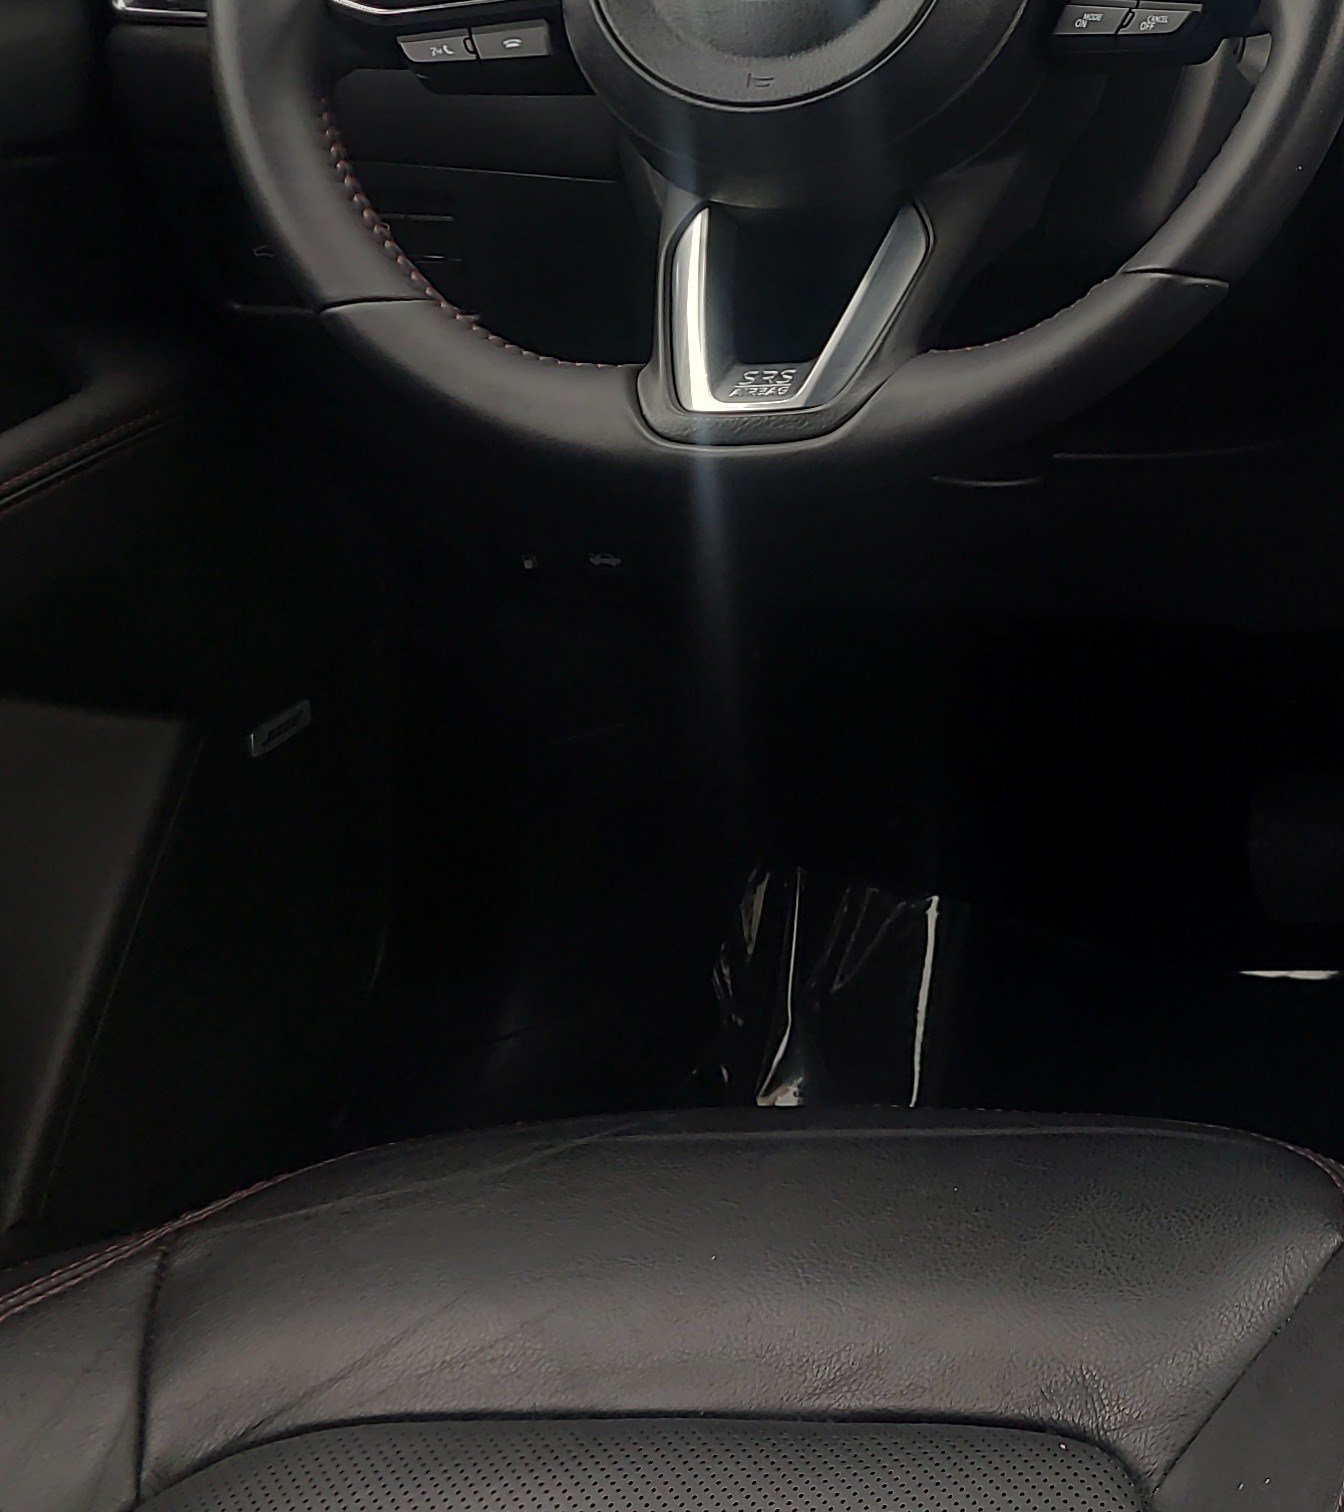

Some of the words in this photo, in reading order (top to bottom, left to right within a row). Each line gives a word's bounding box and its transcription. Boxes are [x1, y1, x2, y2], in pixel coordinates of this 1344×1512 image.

[1083, 13, 1103, 22] MODE
[1148, 15, 1169, 24] CANCEL
[1075, 19, 1087, 28] ON
[1140, 22, 1155, 31] OFF
[739, 369, 797, 385] SRS
